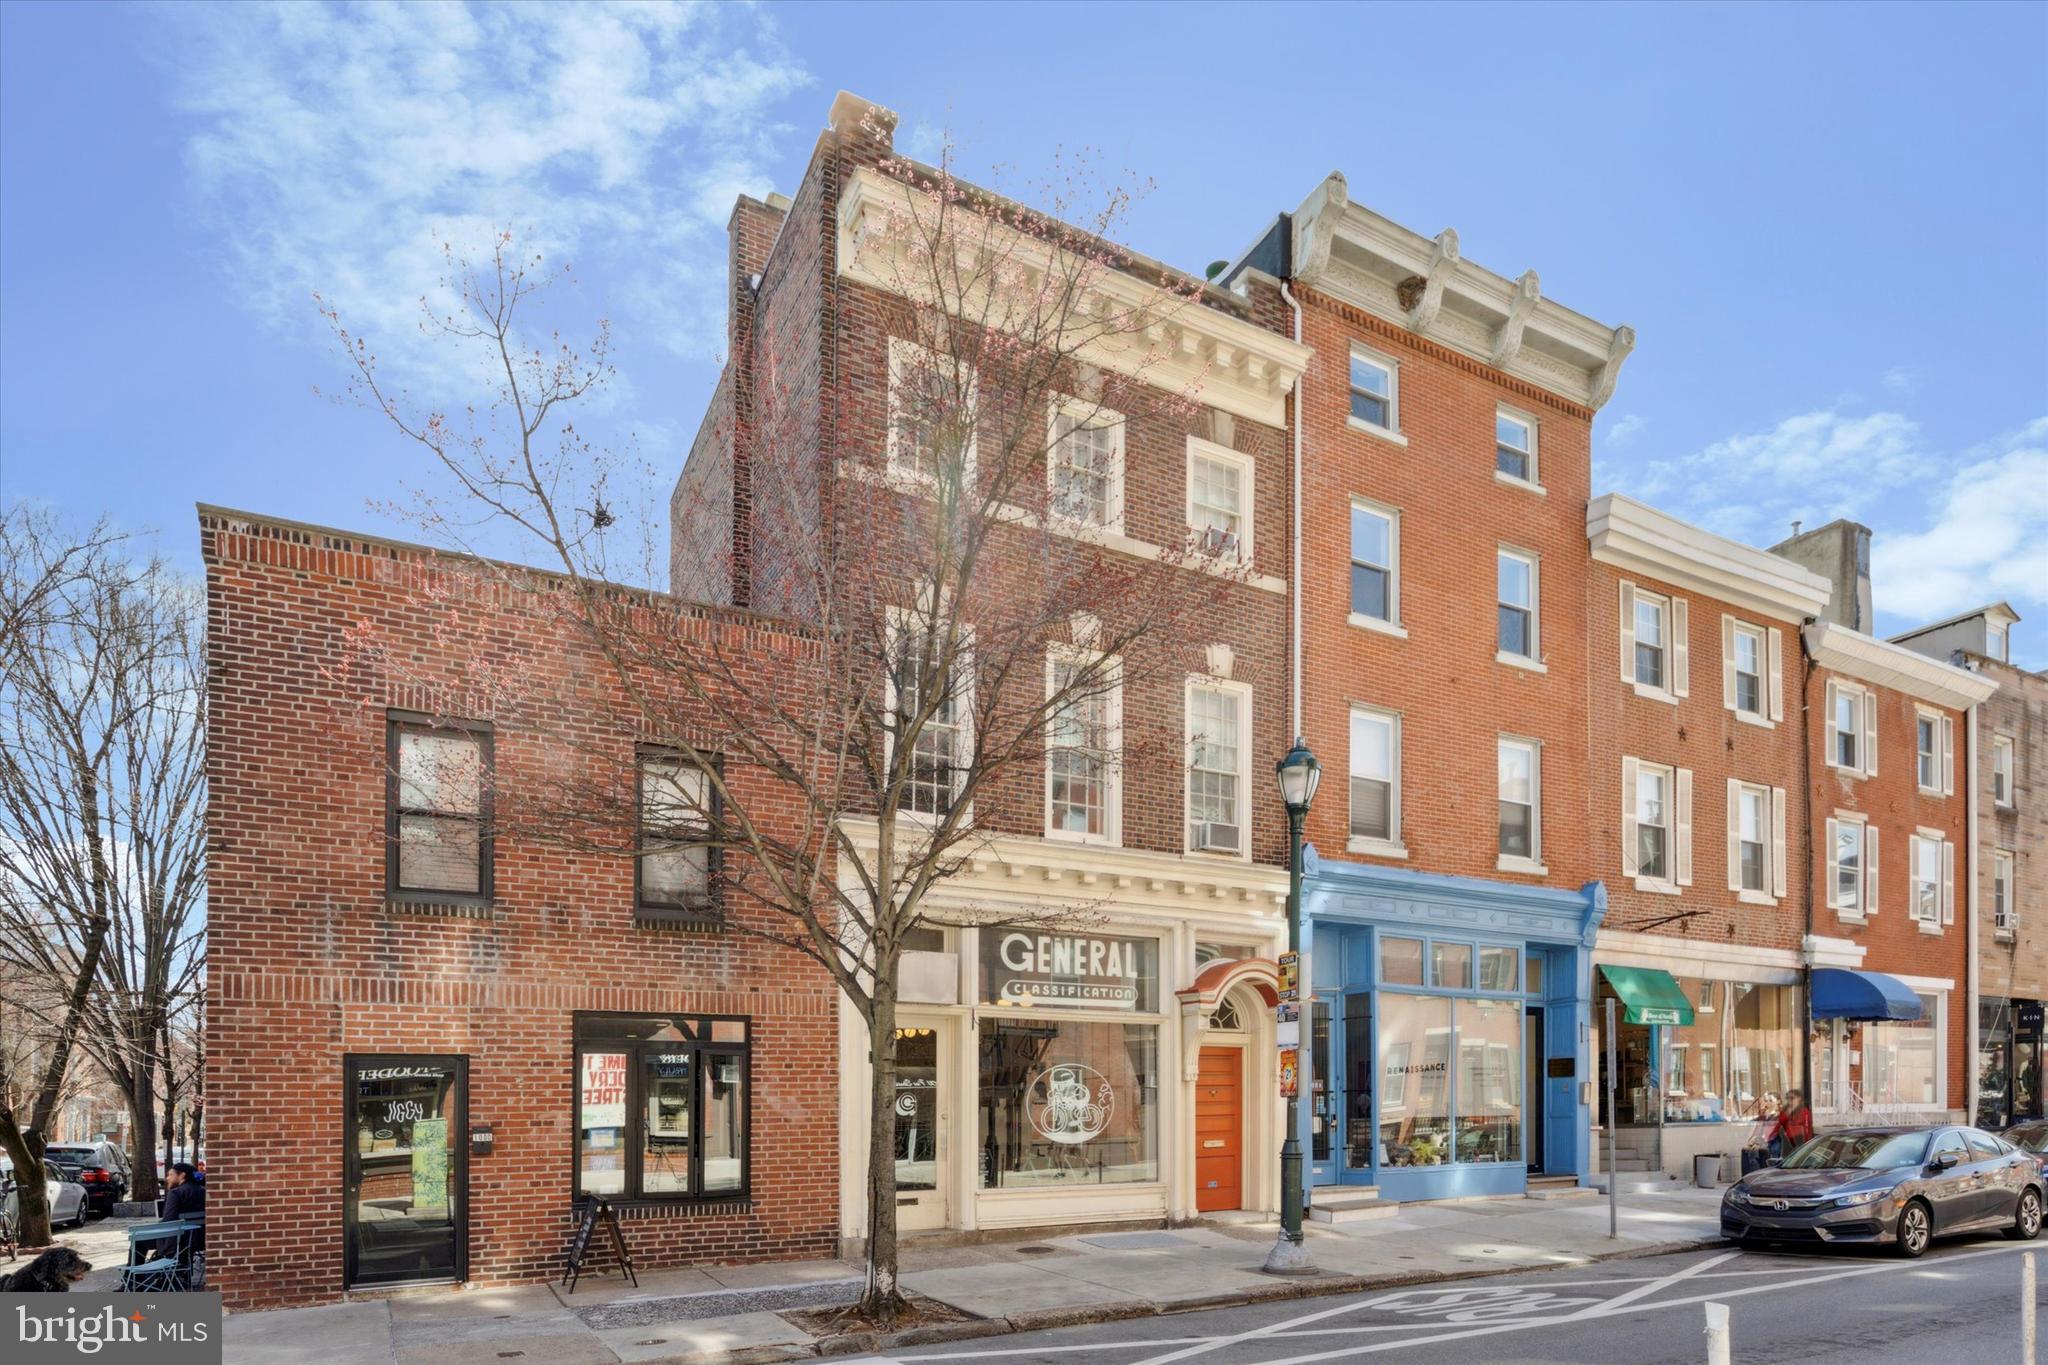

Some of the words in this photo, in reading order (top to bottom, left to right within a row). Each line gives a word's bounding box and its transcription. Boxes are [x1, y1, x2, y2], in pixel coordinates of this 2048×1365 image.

[1000, 933, 1137, 978] GENERAL
[1014, 983, 1132, 999] CLASSIFICATION
[1387, 1063, 1446, 1075] RENAISSANCE
